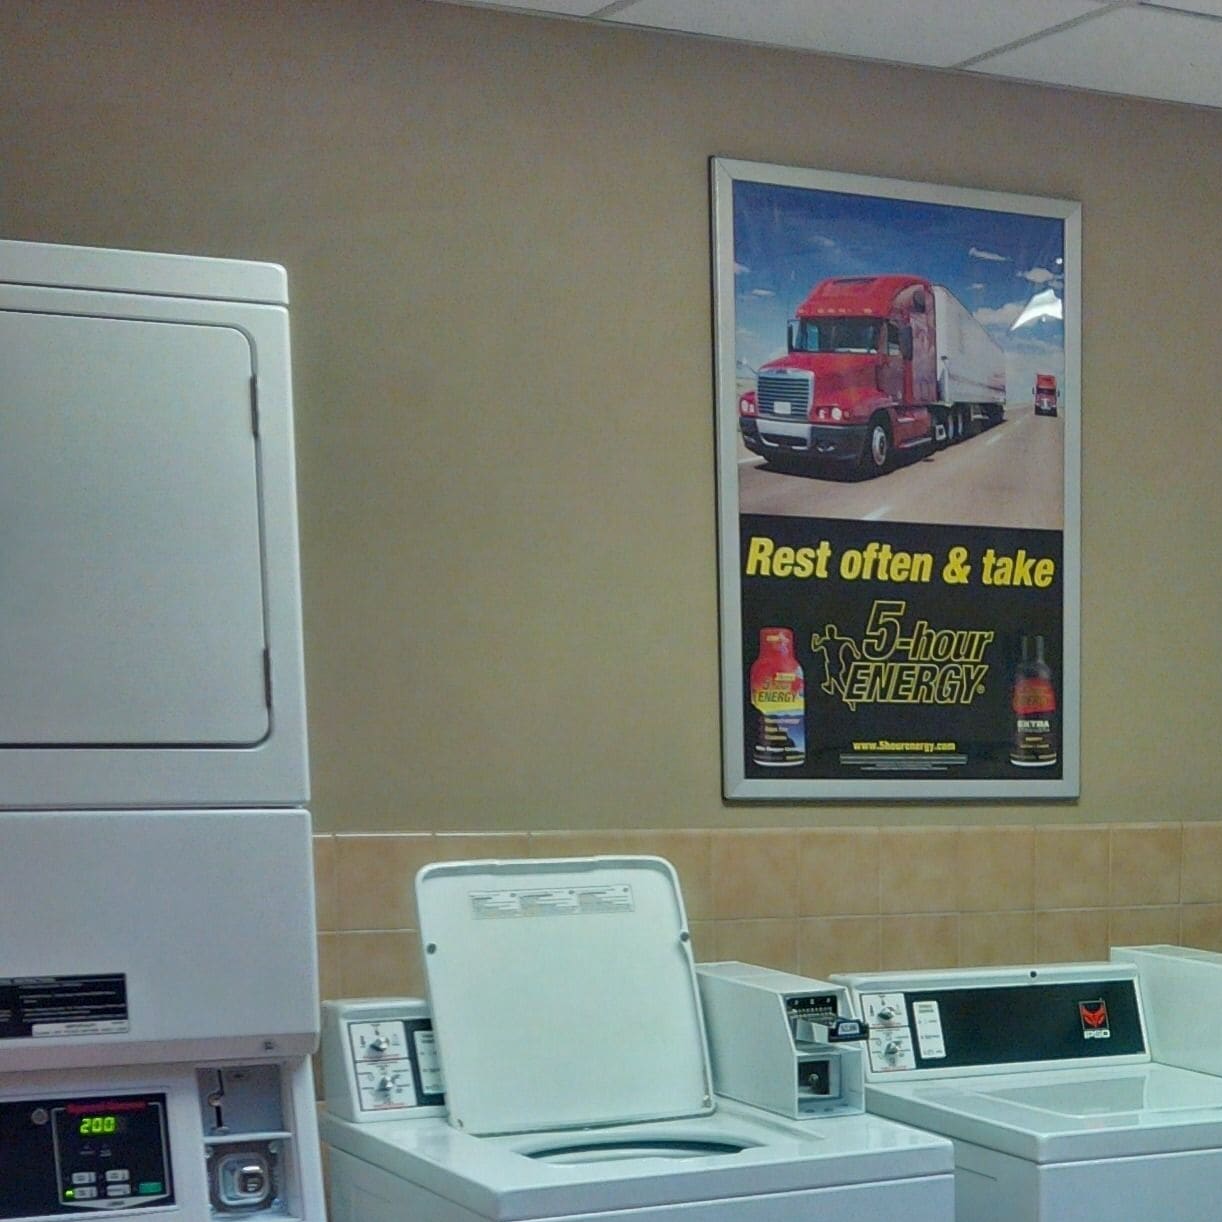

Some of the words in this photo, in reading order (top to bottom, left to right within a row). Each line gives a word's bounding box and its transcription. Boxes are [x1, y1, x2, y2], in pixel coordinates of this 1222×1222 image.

[746, 537, 831, 578] Rest
[840, 542, 933, 582] often
[943, 546, 971, 584] &
[981, 549, 1055, 587] take
[863, 600, 994, 661] 5-hour
[80, 1116, 116, 1134] 200
